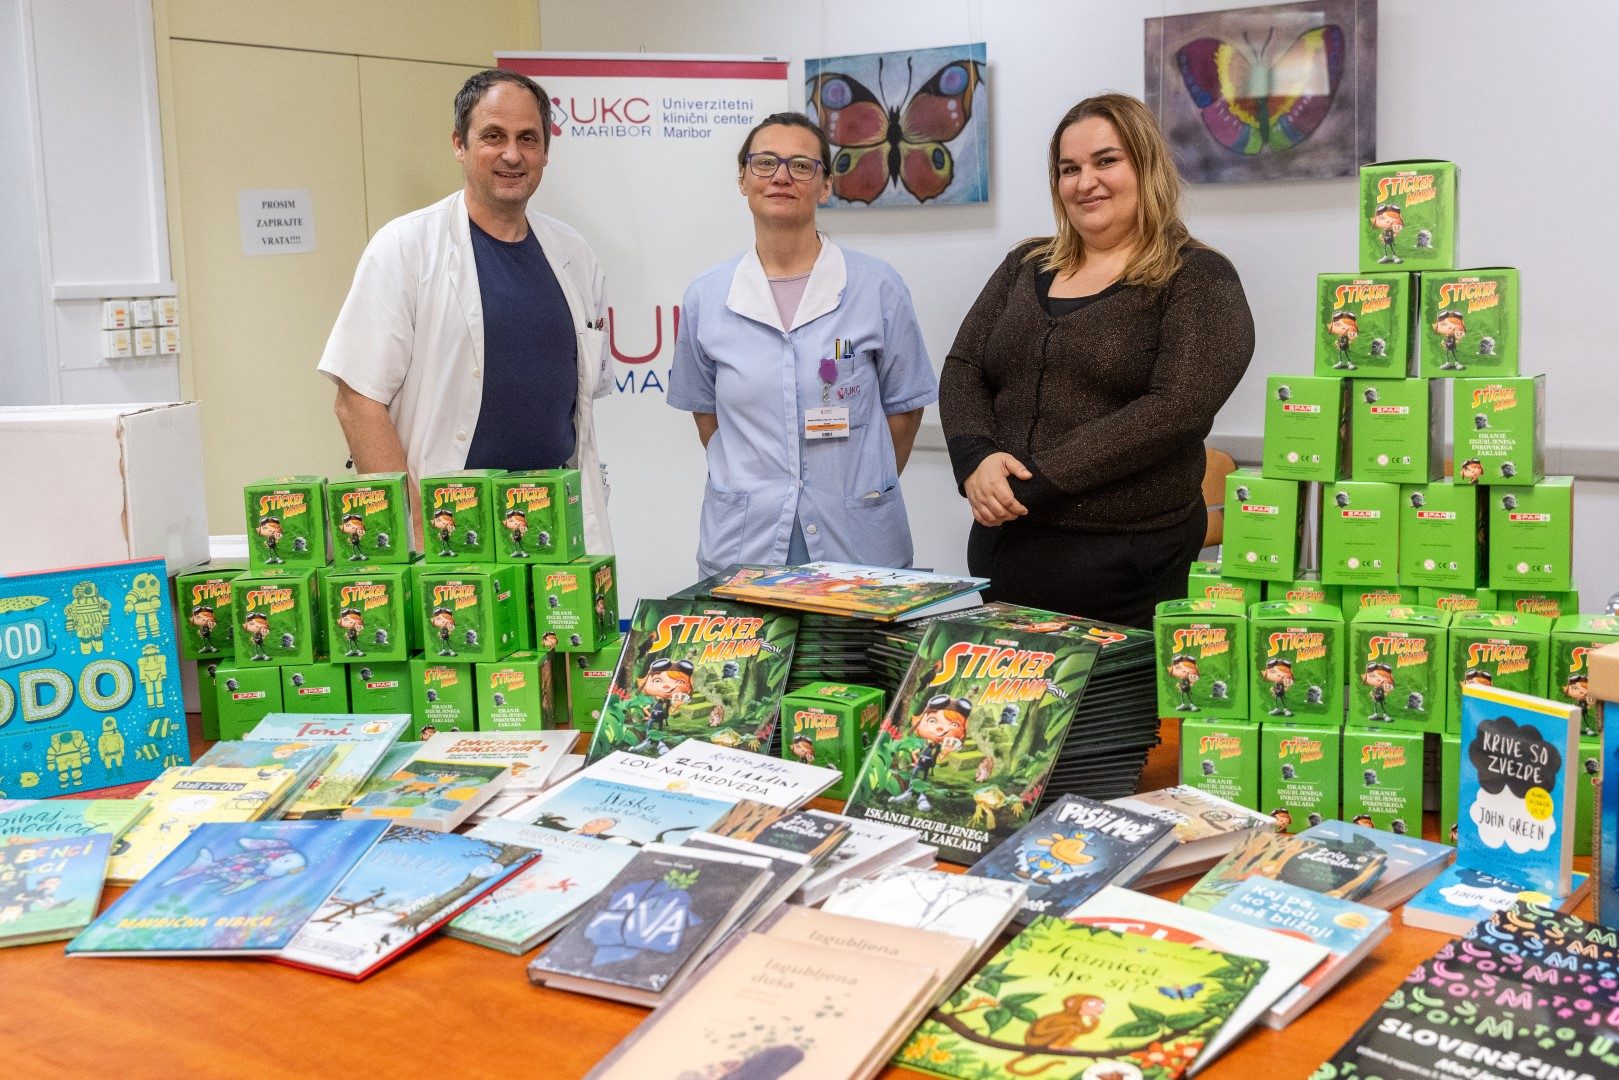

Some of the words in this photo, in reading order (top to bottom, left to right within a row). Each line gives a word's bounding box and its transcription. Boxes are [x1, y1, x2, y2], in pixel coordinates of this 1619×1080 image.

[570, 97, 650, 123] UKC
[662, 98, 753, 110] Univerzitetni
[662, 112, 708, 124] klinični
[714, 114, 753, 124] center
[571, 126, 651, 137] MARIBOR
[664, 127, 712, 138] Maribor
[1377, 175, 1433, 203] STICKER
[262, 200, 295, 209] PROSIM
[256, 218, 303, 228] ZAPIRAJTE
[1334, 284, 1389, 310] STICKER
[1438, 282, 1497, 309] STICKER
[259, 493, 304, 516] STICKER
[342, 490, 385, 513] STICKER
[434, 487, 476, 508] STICKER
[506, 487, 549, 509] STICKER
[246, 589, 292, 612] STICKER
[341, 585, 386, 607] STICKER
[433, 584, 476, 606] STICKER
[648, 614, 764, 654] STICKER
[1173, 628, 1227, 654] STICKER
[1268, 632, 1325, 657] STICKER
[1367, 636, 1427, 661] STICKER
[1467, 638, 1528, 668] STICKER
[929, 642, 1056, 687] STICKER
[297, 722, 354, 737] Toni
[793, 711, 838, 733] STICKER
[1483, 731, 1522, 759] KRIVE
[1530, 744, 1549, 765] SO
[620, 757, 658, 770] LOV
[658, 766, 683, 777] NA
[690, 773, 768, 796] MEDVEDA
[1488, 754, 1543, 784] ZVEZDE
[175, 781, 200, 790] Mali
[864, 807, 909, 826] ISKANJE
[910, 817, 989, 843] IZGUBLJENEGA
[1478, 807, 1505, 828] JOHN
[1508, 817, 1545, 841] GREEN
[930, 835, 982, 853] ZAKLADA
[1251, 885, 1285, 901] Kaj
[1240, 893, 1265, 906] ko
[1267, 902, 1320, 922] zboli
[808, 930, 899, 957] Izgubljena
[764, 958, 859, 987] Izgubljena
[1048, 963, 1092, 985] kje
